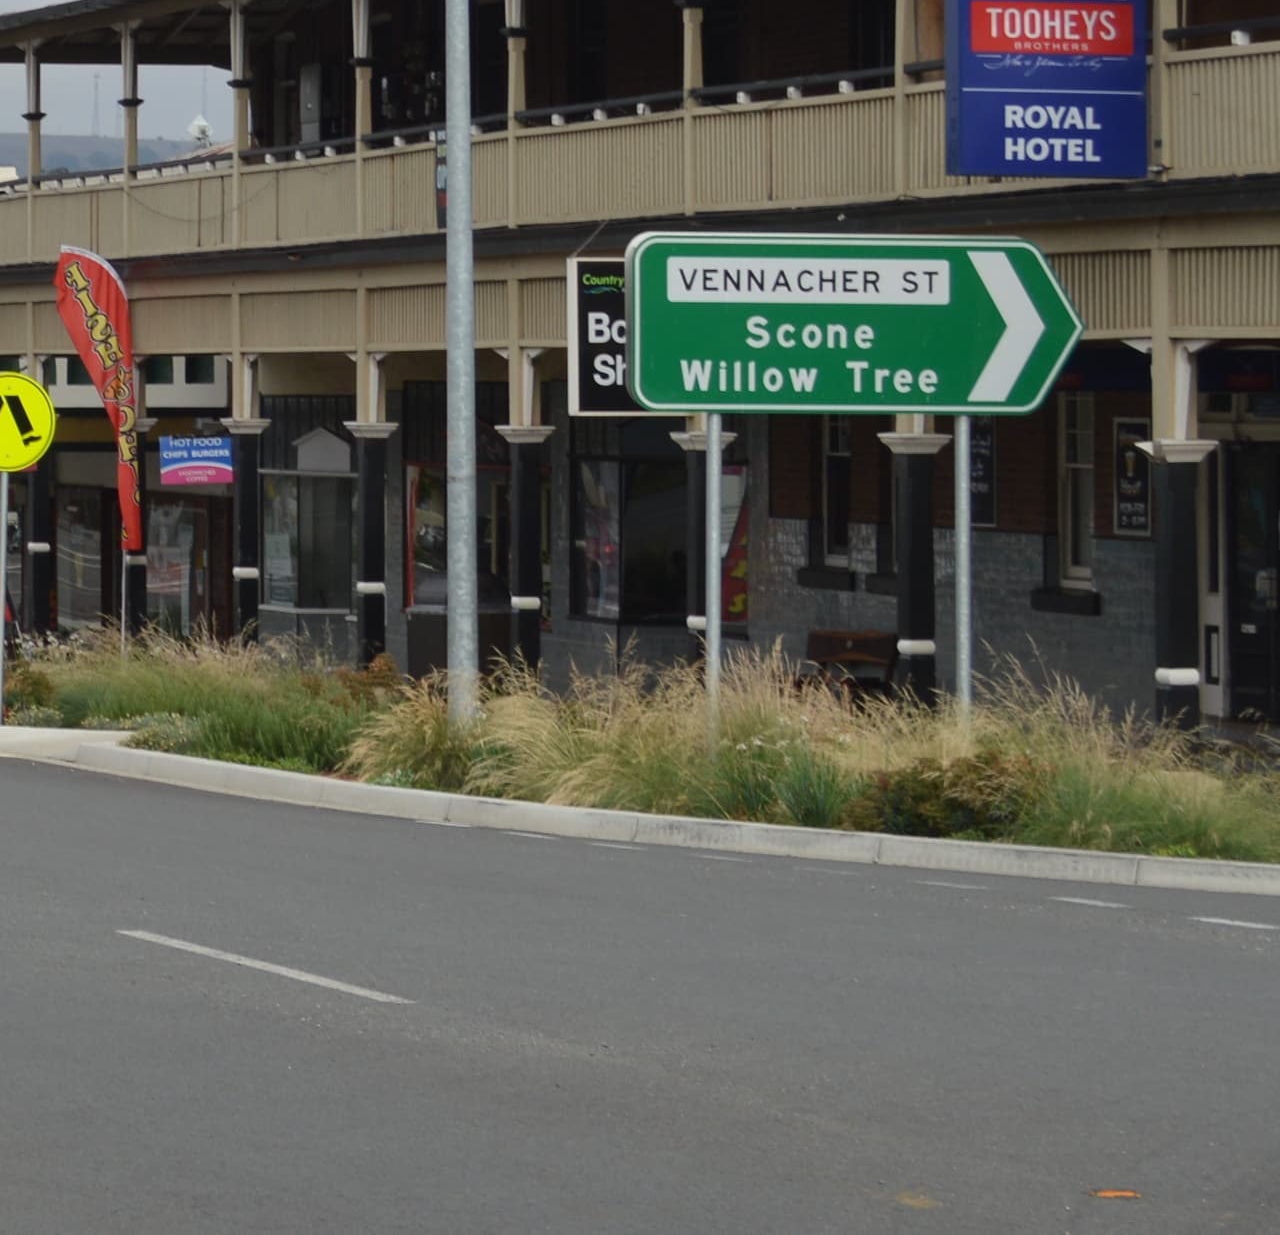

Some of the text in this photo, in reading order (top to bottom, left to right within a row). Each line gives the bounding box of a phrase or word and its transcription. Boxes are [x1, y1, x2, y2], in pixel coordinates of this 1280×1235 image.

[986, 8, 1116, 41] TOOHEYS
[1014, 41, 1089, 52] BROTHERS
[1004, 105, 1101, 130] ROYAL
[1004, 137, 1101, 162] HOTEL
[678, 269, 939, 294] VENNACHER ST
[746, 316, 875, 349] Scone
[680, 359, 939, 394] Willow Tree
[169, 437, 222, 447] HOT FOOD
[191, 449, 230, 458] BURGERS
